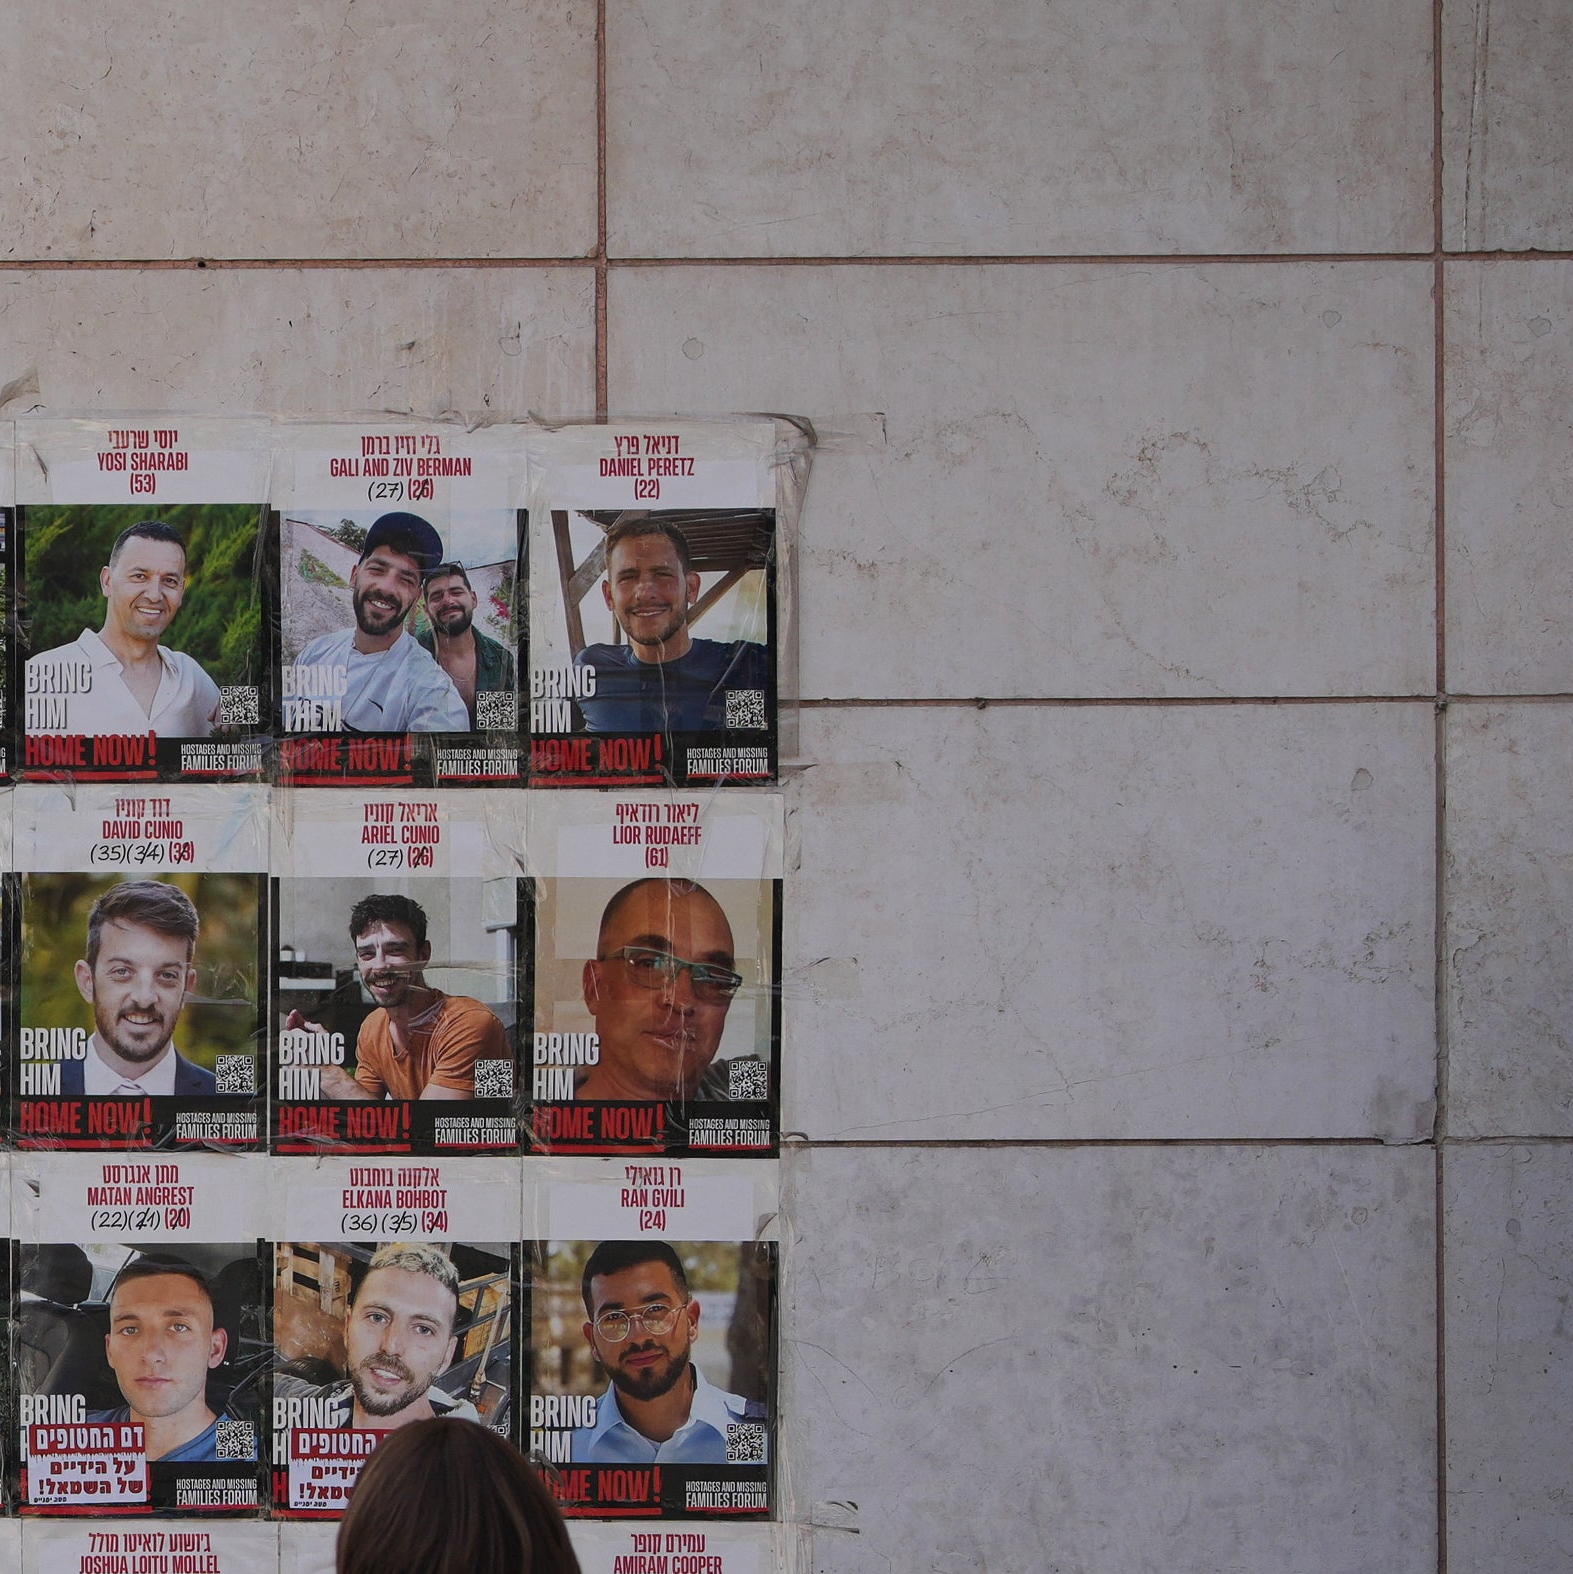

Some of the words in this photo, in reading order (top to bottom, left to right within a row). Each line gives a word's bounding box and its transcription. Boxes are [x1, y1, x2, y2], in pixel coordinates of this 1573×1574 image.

[98, 452, 128, 472] YOSI
[130, 451, 189, 471] SHARABI
[330, 458, 360, 478] GALI
[363, 457, 390, 477] AND
[393, 457, 414, 477] ZIV
[416, 457, 473, 477] BERMAN
[599, 457, 643, 477] DANIEL
[647, 457, 695, 477] PERETZ
[130, 473, 157, 494] (53)
[282, 664, 348, 697] BRING
[283, 700, 344, 732] THEM
[102, 820, 142, 840] DAVID
[145, 820, 184, 840] CUNIO
[361, 824, 397, 845] ARIEL
[402, 825, 441, 845] CUNIO
[613, 825, 642, 845] LIOR
[87, 1186, 133, 1206] MATAN
[135, 1186, 195, 1206] ANGREST
[342, 1189, 393, 1209] ELKANA
[396, 1189, 447, 1210] BOHBOT
[621, 1188, 649, 1207] RAN
[652, 1188, 685, 1208] GVILI
[632, 1533, 663, 1554] קופר
[665, 1533, 706, 1553] עמירם
[80, 1555, 129, 1574] JOSHUA
[132, 1554, 169, 1574] LOITU
[172, 1554, 220, 1574] MOLLEL
[614, 1555, 670, 1574] AMIRAM
[672, 1555, 723, 1574] COOPER
